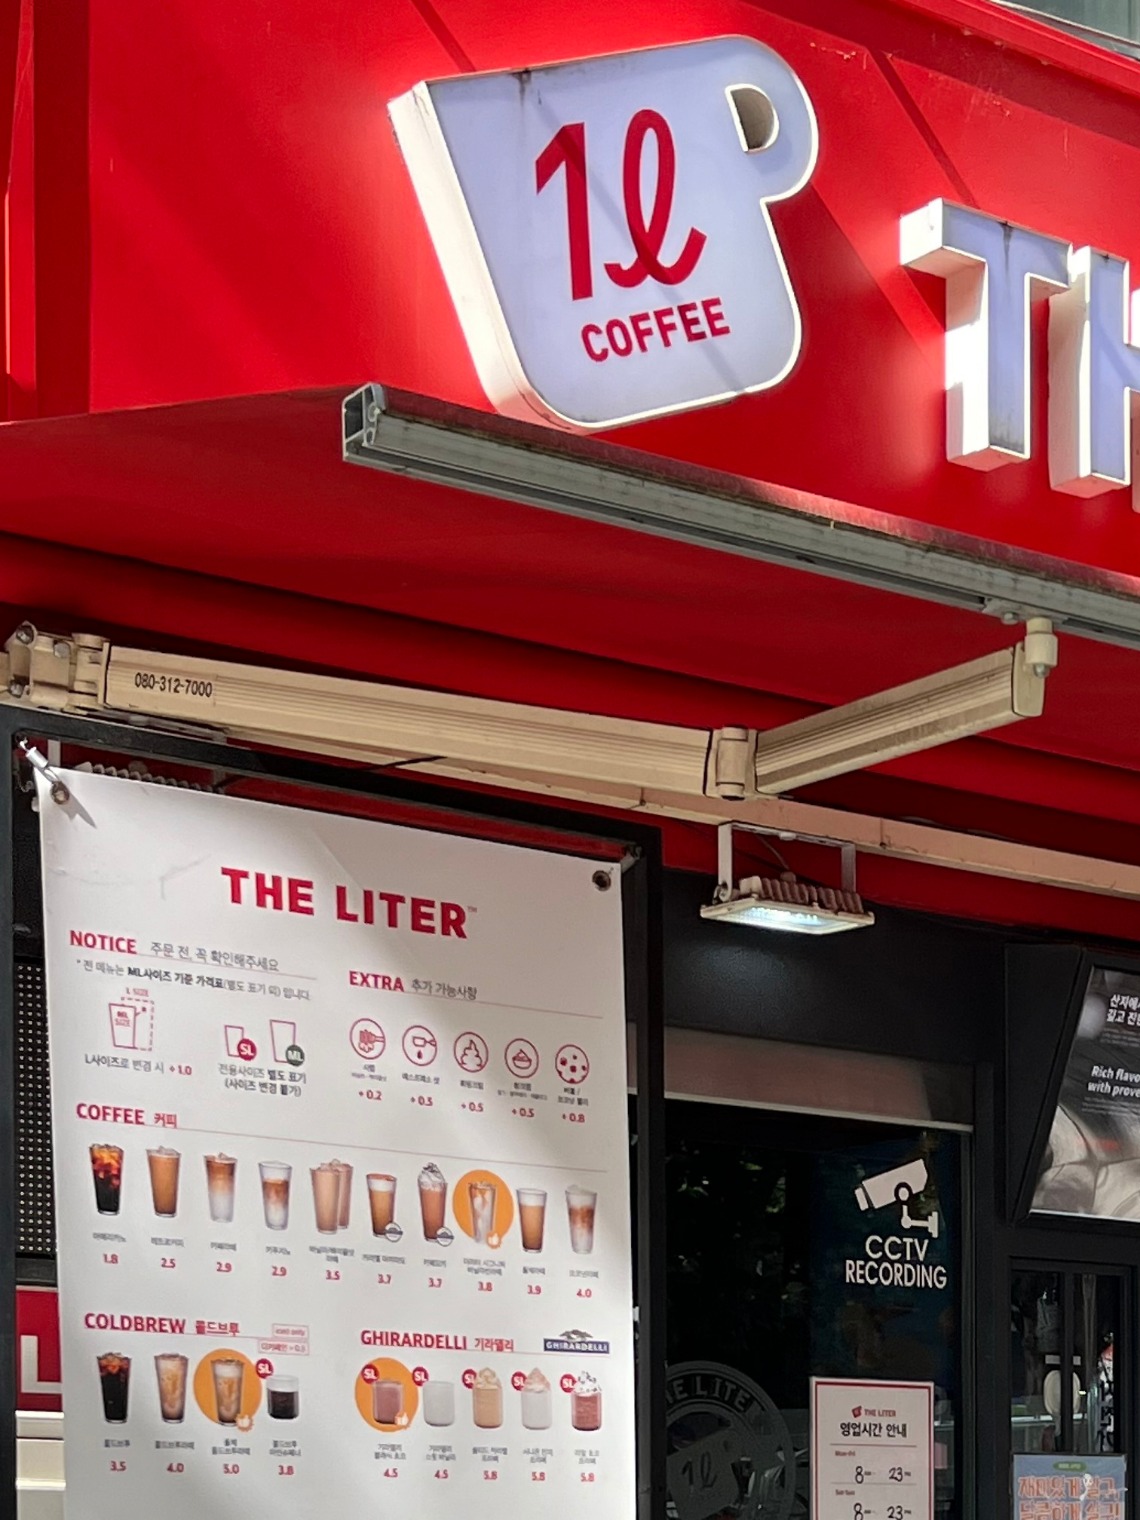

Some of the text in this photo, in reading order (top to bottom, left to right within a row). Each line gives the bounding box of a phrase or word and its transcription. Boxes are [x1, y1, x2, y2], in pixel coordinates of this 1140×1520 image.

[580, 296, 731, 362] COFFEE
[133, 671, 214, 699] 080-312-7000
[220, 866, 468, 940] THE LITER
[69, 929, 138, 955] NOTICE
[349, 970, 405, 993] EXTRA
[1091, 1066, 1114, 1080] Rich
[1088, 1080, 1111, 1094] with
[76, 1102, 178, 1129] COFFEE 커피
[865, 1235, 930, 1261] CCTV
[845, 1259, 948, 1290] RECORDING
[84, 1312, 187, 1335] COLDBREW
[360, 1329, 468, 1350] GHIRARDELLI
[840, 1422, 908, 1439] 영업시간 안내
